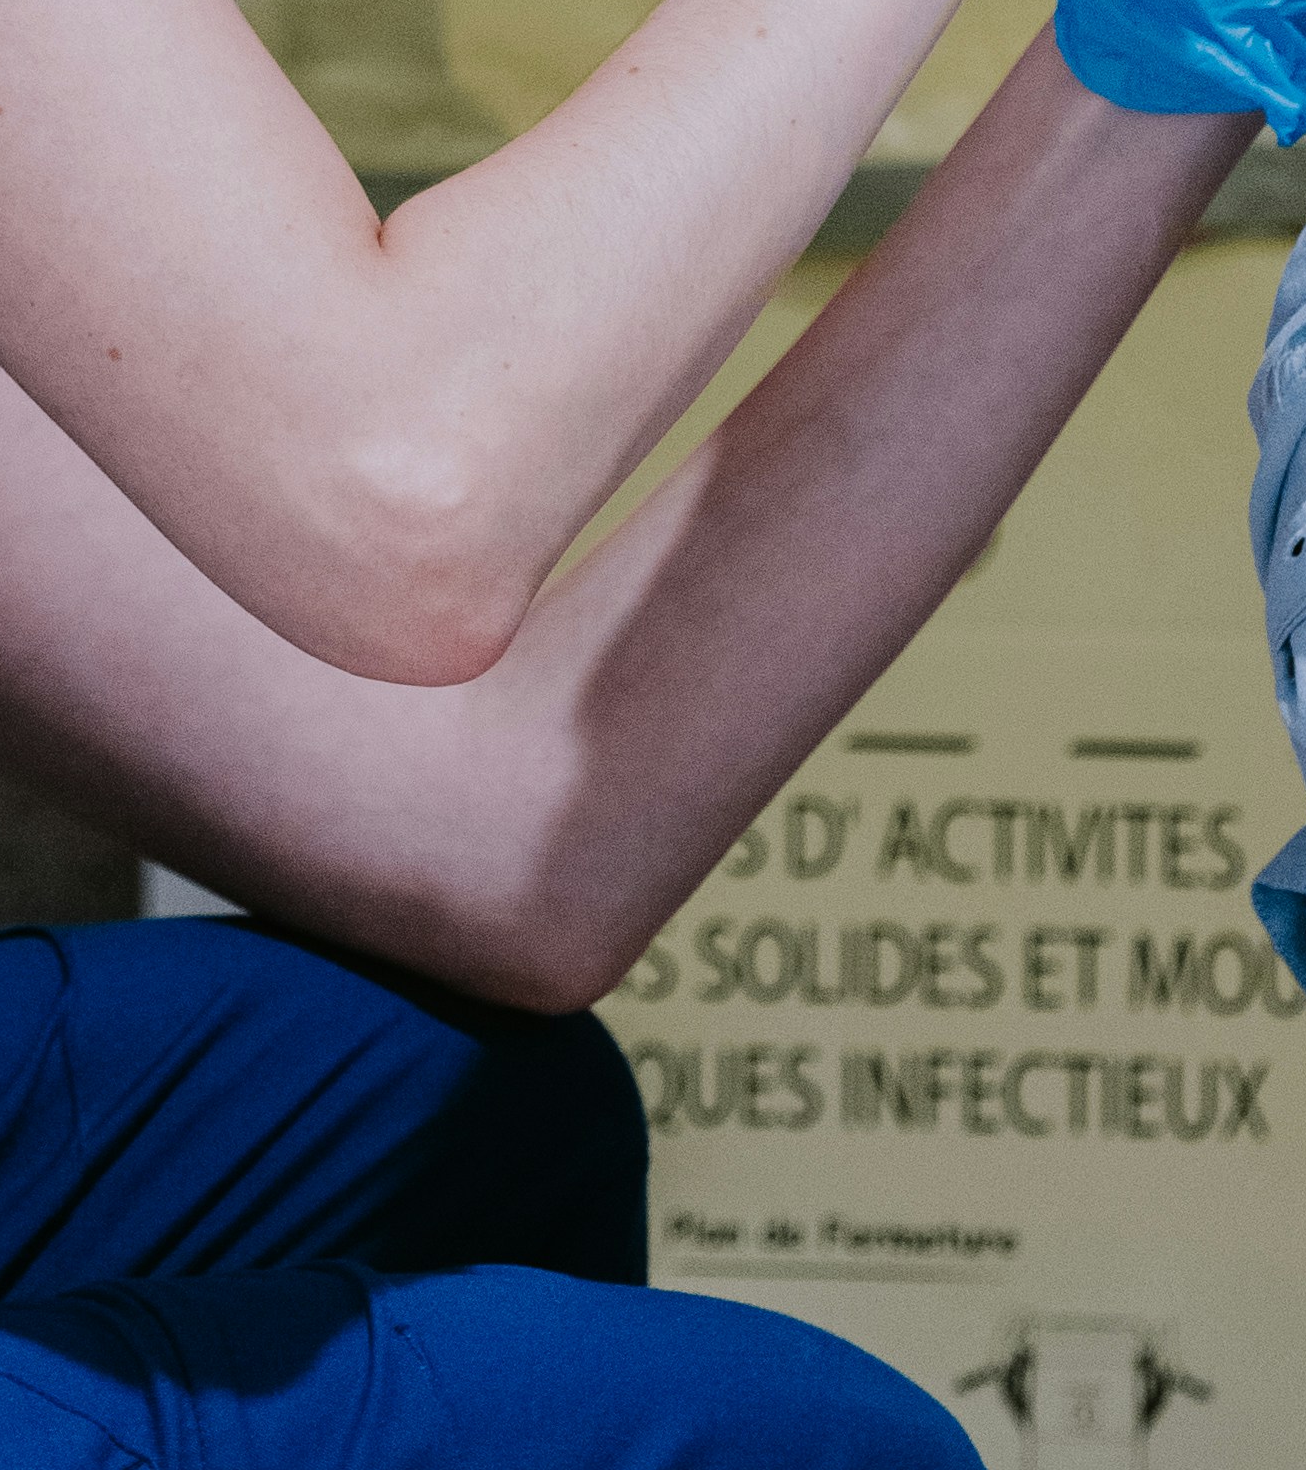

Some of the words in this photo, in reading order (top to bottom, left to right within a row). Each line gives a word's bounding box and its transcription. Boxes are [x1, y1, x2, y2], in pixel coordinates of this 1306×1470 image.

[785, 793, 861, 881] D'
[875, 796, 1249, 891] ACTIVITES
[695, 916, 1005, 1011] SOLIDES
[1020, 924, 1111, 1012] ET
[629, 1039, 825, 1136] QUES
[840, 1047, 1271, 1143] INFECTIEUX
